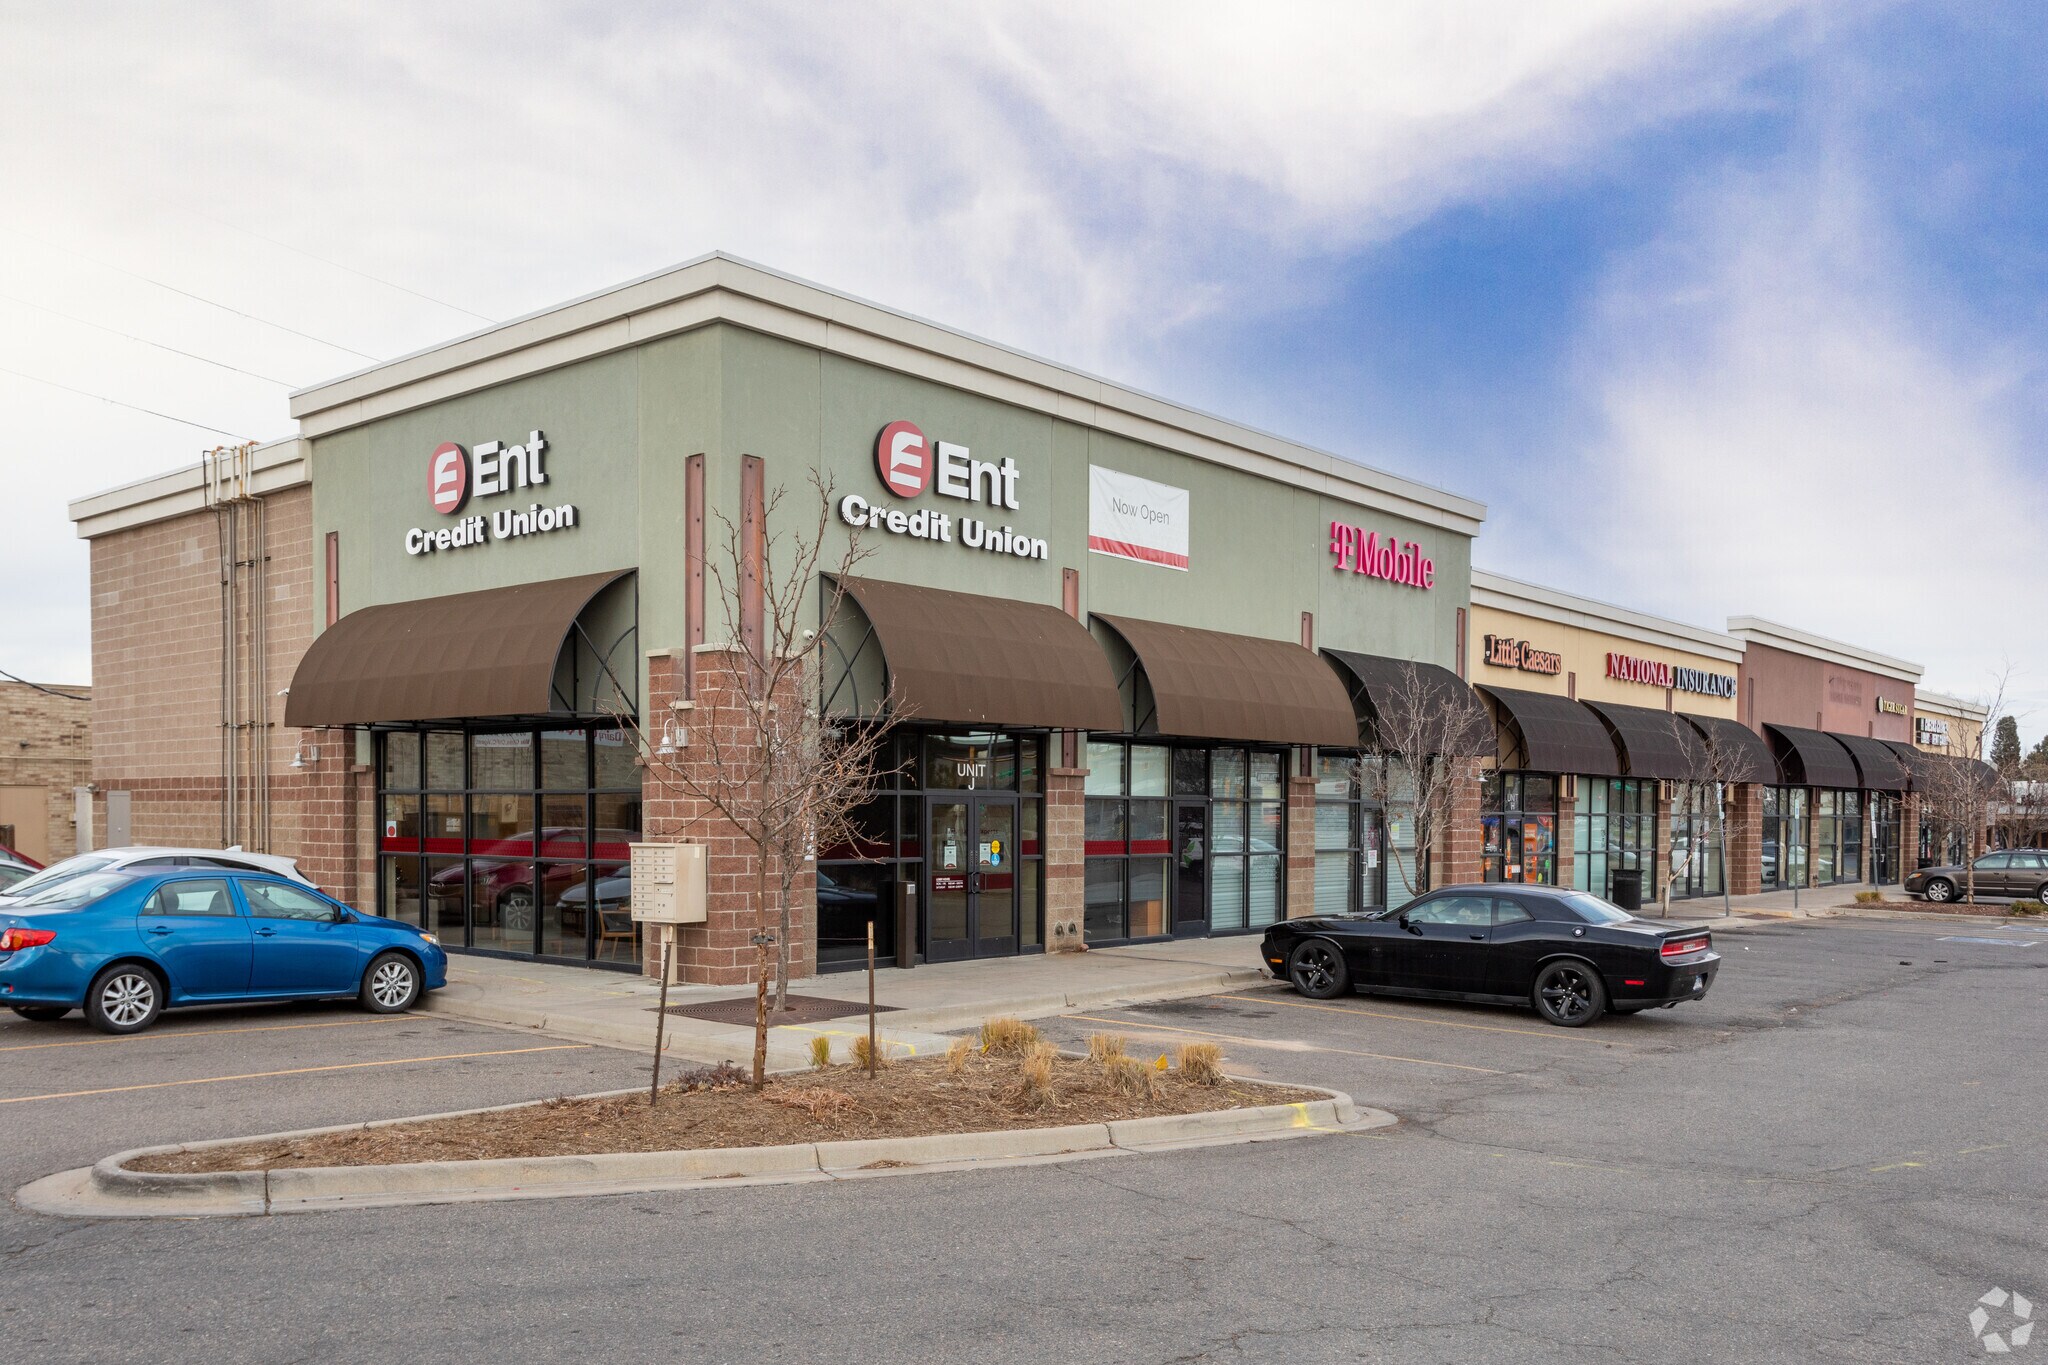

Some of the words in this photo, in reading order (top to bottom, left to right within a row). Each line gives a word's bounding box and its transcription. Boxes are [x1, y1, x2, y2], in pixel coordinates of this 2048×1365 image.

[473, 430, 547, 497] Ent
[935, 441, 1020, 510] Ent
[405, 515, 486, 555] Credit
[493, 503, 577, 539] Union
[839, 495, 951, 542] Credit
[959, 518, 1048, 560] Union
[1112, 496, 1138, 517] Now
[1140, 504, 1170, 525] Open
[1488, 635, 1520, 667] Little
[1520, 641, 1561, 674] Caesars
[1606, 652, 1674, 688] NATIONAL
[1674, 666, 1737, 698] INSURANCE
[957, 763, 986, 777] UNIT
[968, 777, 975, 790] J
